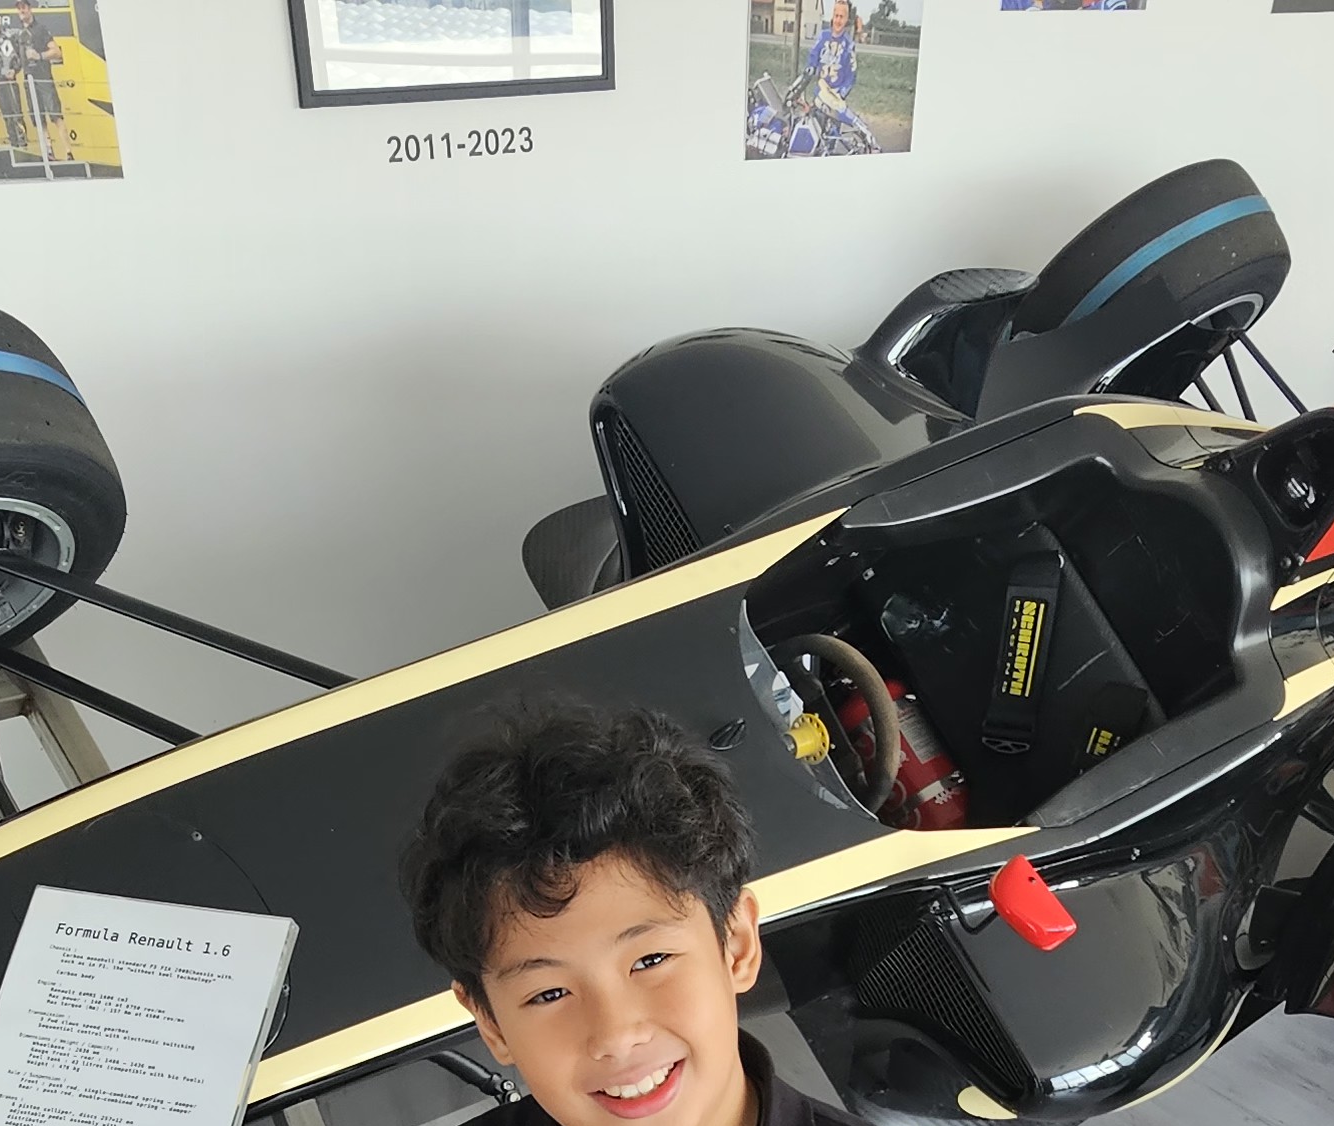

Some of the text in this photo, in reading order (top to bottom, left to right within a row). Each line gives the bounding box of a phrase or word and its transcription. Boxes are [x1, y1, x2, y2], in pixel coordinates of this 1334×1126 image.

[387, 126, 534, 163] 2011-2023
[1009, 600, 1037, 697] SCHROTH
[55, 923, 232, 958] Formula Renault 1.6
